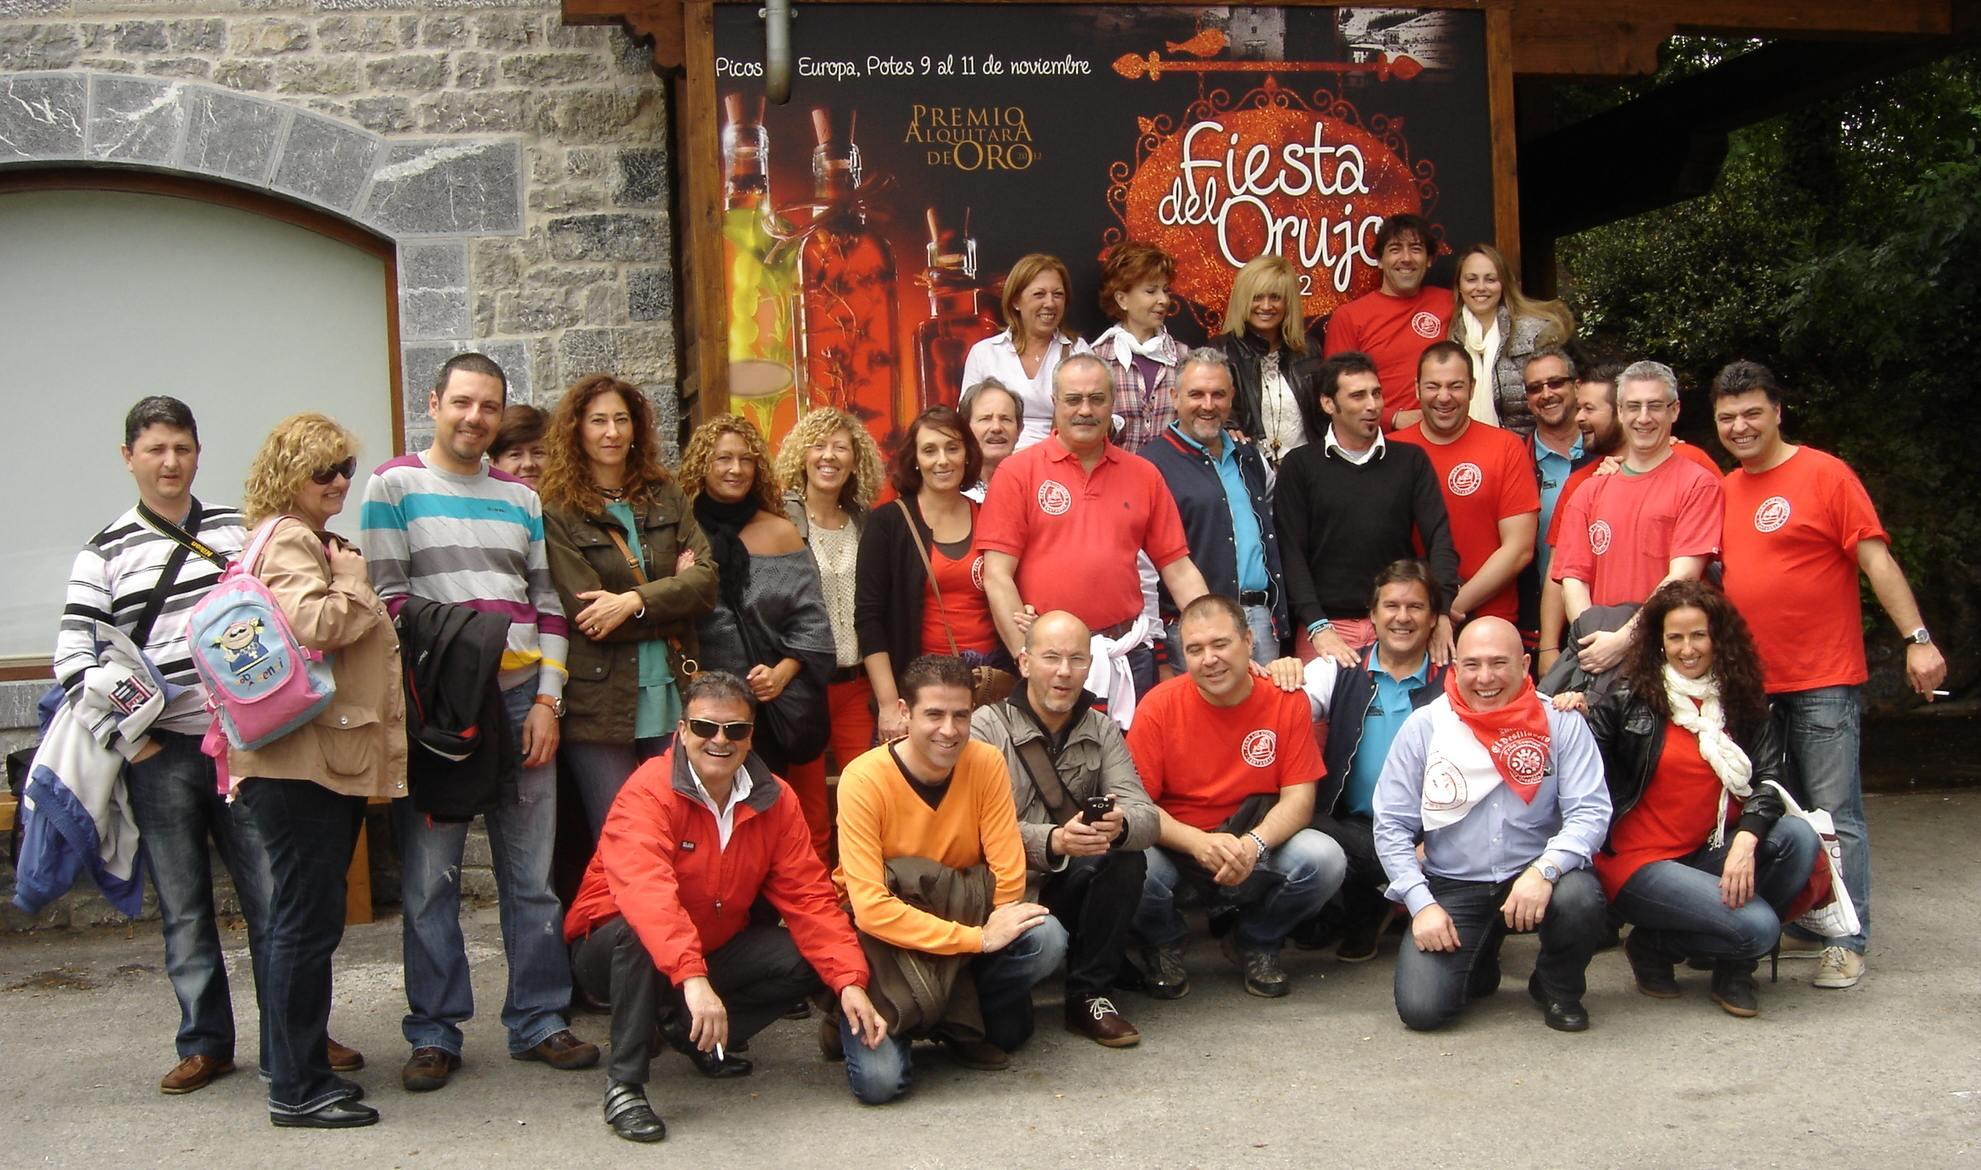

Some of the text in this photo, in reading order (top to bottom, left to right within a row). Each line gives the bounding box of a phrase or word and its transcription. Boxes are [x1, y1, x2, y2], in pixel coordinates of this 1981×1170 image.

[715, 53, 1092, 81] Picos Europa, Potes 9 al 11 de noviembre
[912, 104, 1025, 127] PREMIO
[927, 151, 952, 165] DE
[953, 140, 1033, 171] ORO
[1180, 120, 1369, 198] Fiesta
[1158, 177, 1220, 225] del
